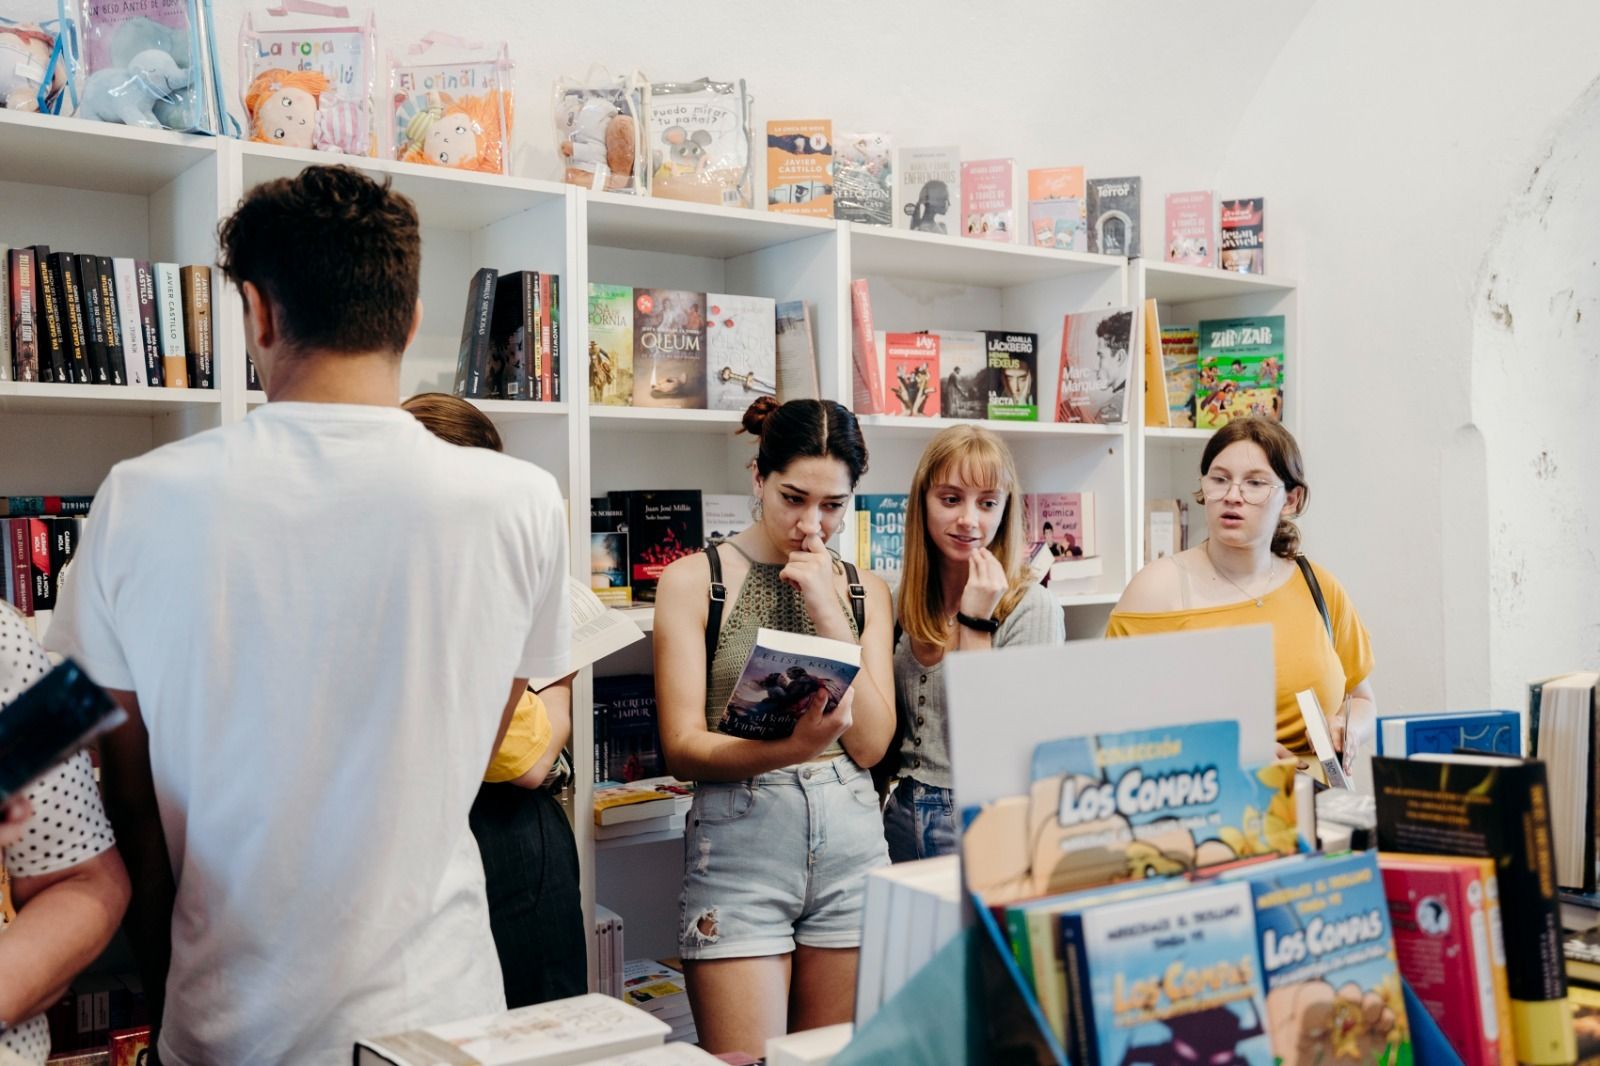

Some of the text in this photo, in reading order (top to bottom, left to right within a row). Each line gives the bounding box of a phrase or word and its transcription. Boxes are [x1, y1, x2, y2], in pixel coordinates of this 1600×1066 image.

[256, 40, 282, 57] La
[298, 58, 312, 72] de
[694, 105, 727, 118] mirar
[1097, 185, 1130, 198] Terror
[139, 268, 147, 304] CASTILLO
[168, 302, 176, 339] CASTILLO
[641, 332, 700, 352] OLEUM
[989, 359, 1020, 368] FEXEUS
[1063, 367, 1090, 378] Marc
[1042, 508, 1074, 518] química
[763, 653, 845, 672] ELISE KOVA
[619, 708, 651, 720] JAIPUR
